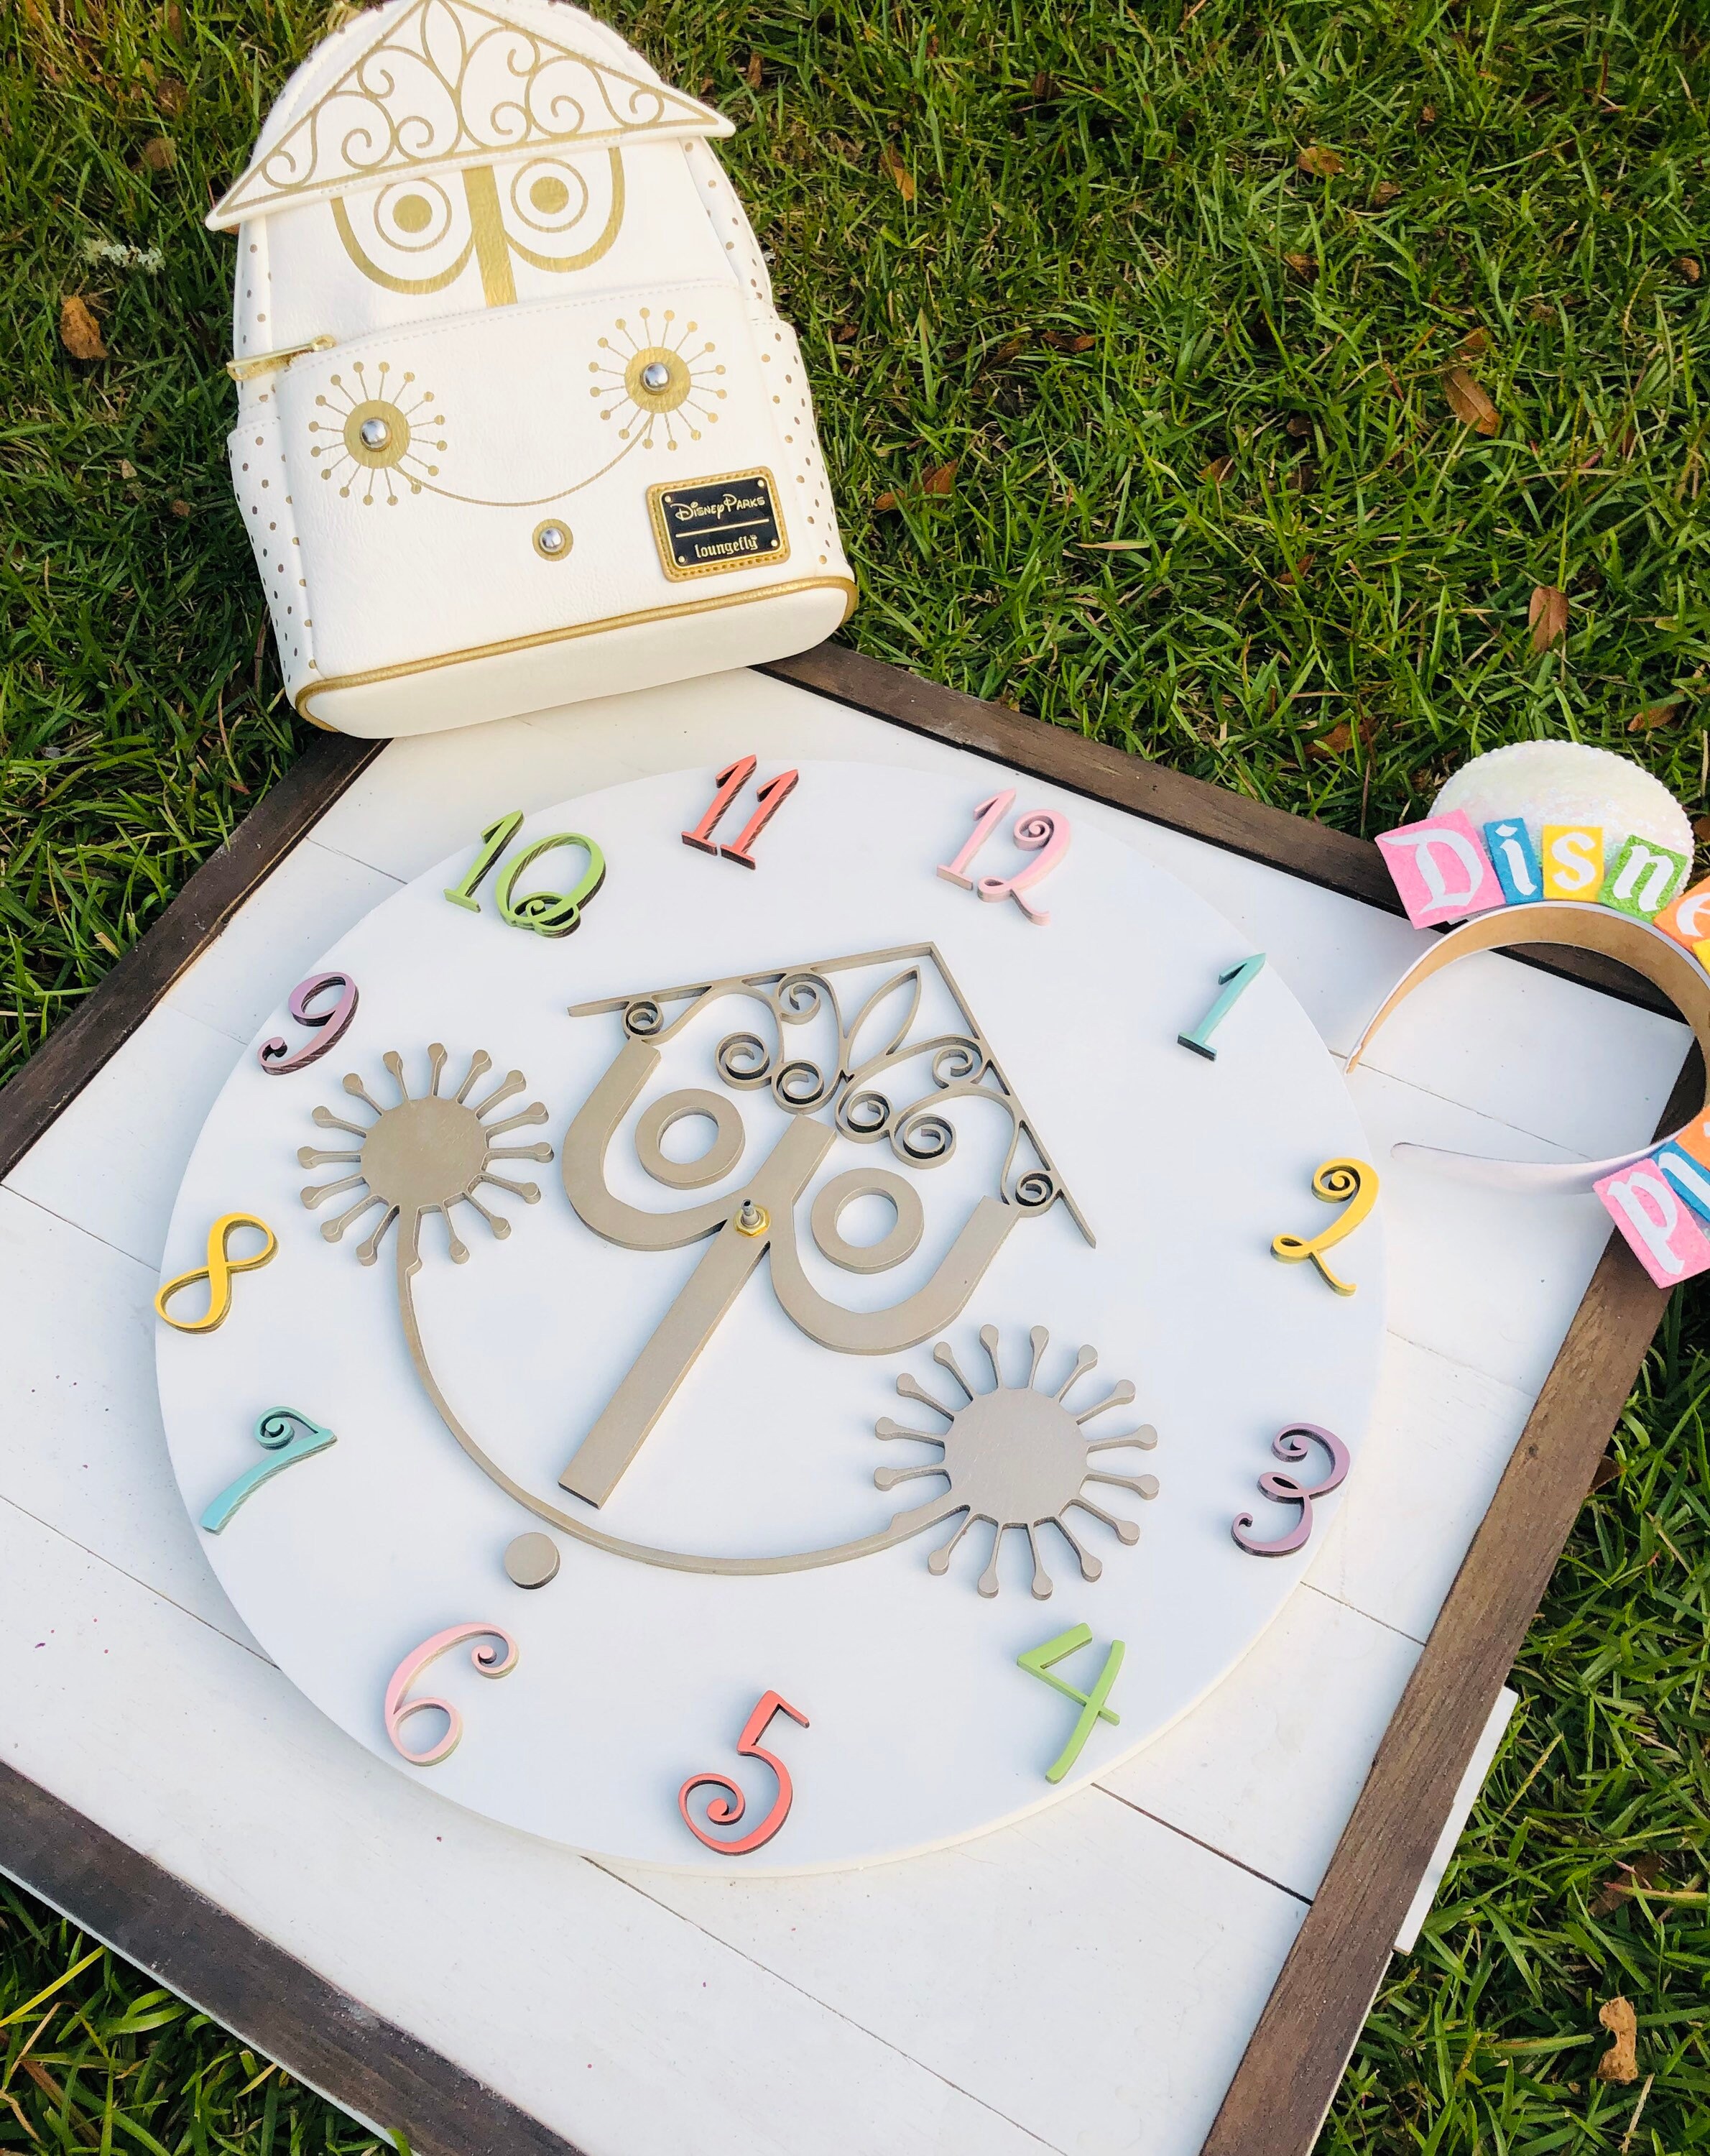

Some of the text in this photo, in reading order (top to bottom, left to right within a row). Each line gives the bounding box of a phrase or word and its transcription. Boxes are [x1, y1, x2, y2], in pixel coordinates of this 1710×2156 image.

[694, 535, 758, 558] loungefly
[444, 810, 606, 938] 10
[681, 755, 799, 870] 11
[936, 788, 1071, 926] 12
[258, 972, 359, 1075] 9
[1178, 953, 1265, 1061] 1
[155, 1212, 279, 1334] 8
[1270, 1157, 1379, 1296] 2
[200, 1406, 337, 1535] 7
[1231, 1422, 1351, 1557] 3
[384, 1622, 519, 1766] 6
[1017, 1623, 1124, 1784] 4
[678, 1690, 810, 1856] 5
